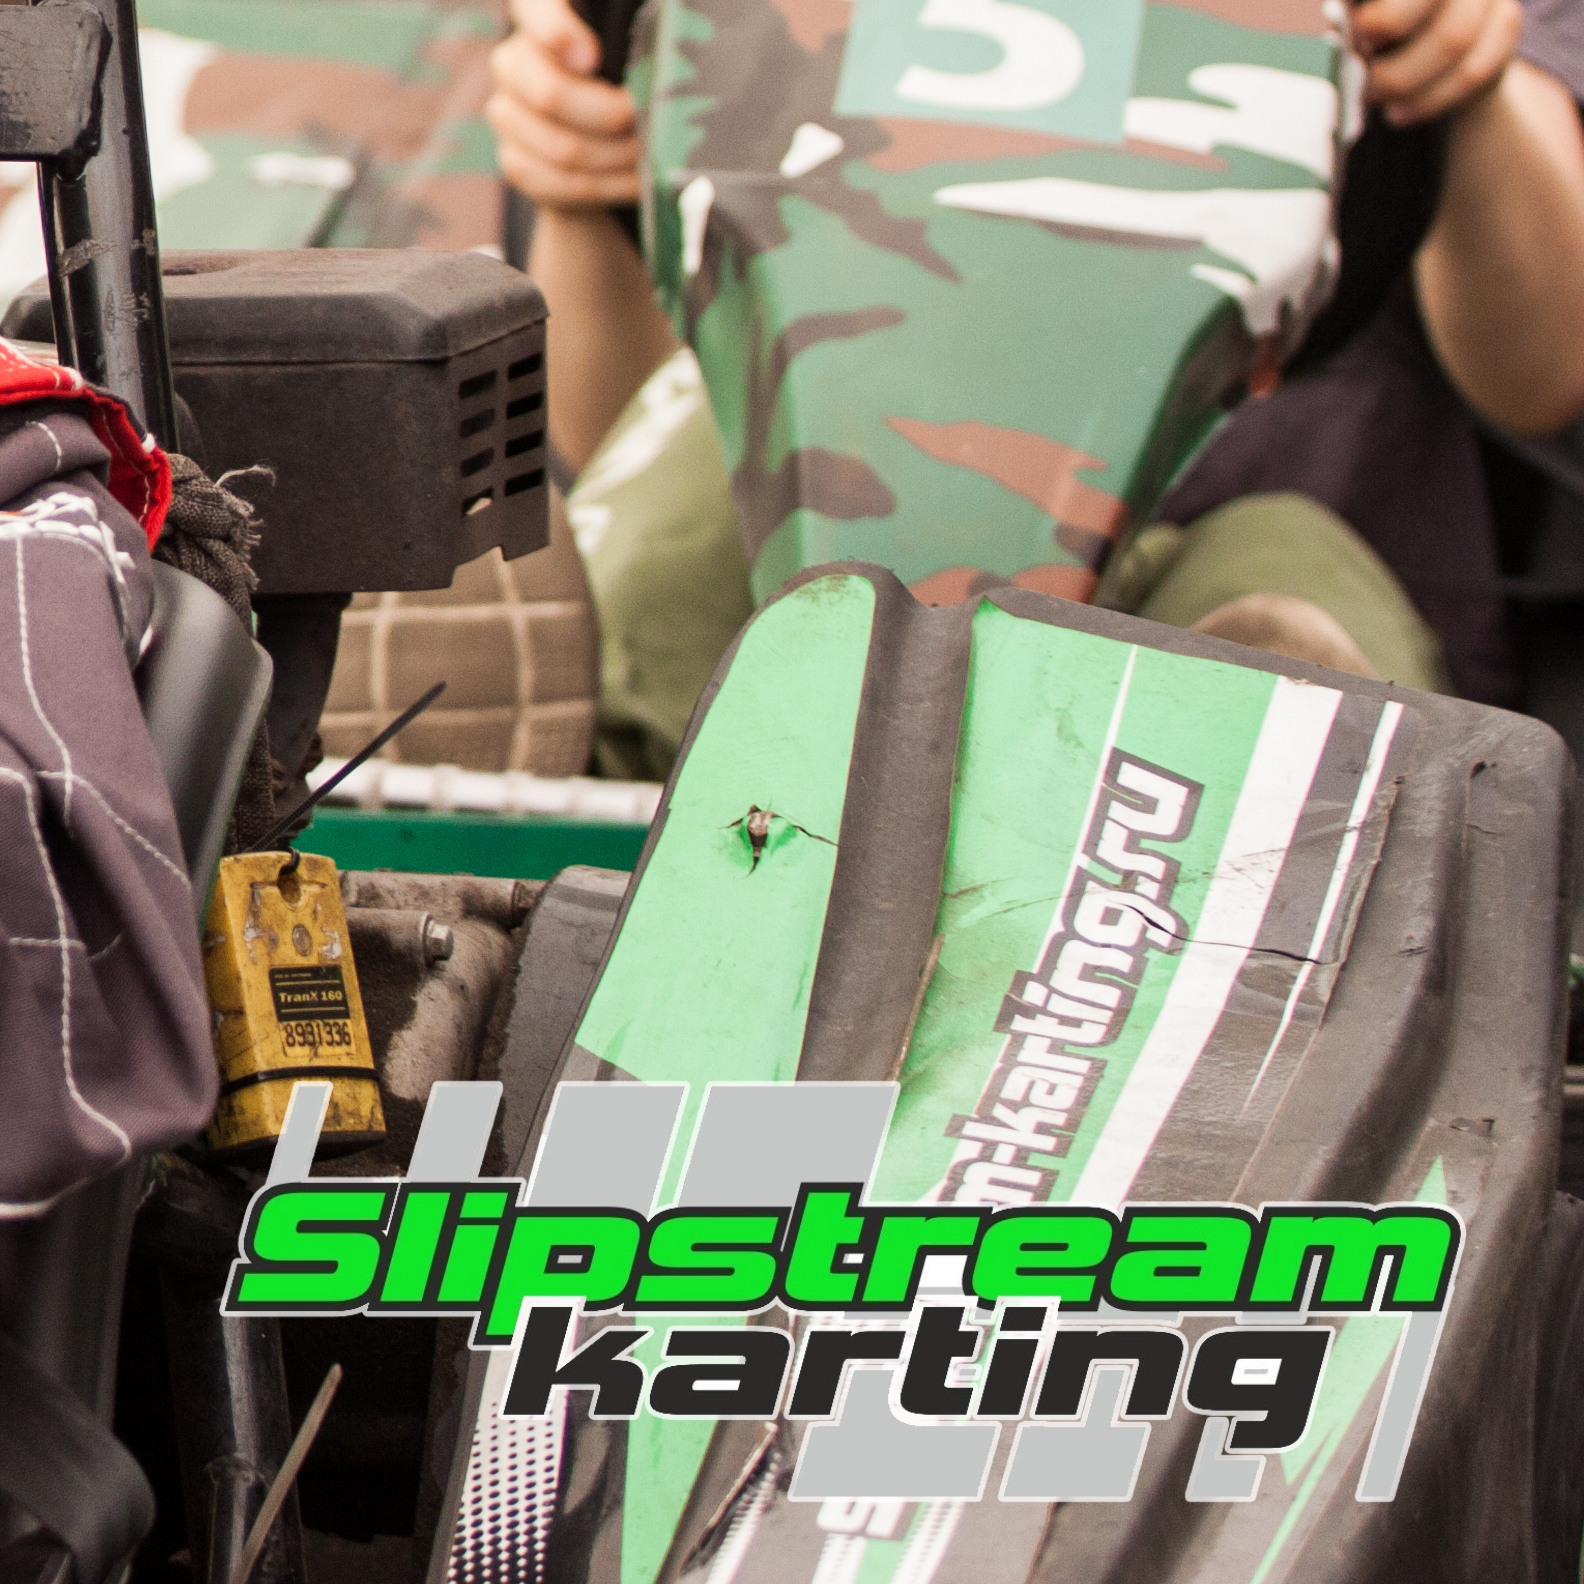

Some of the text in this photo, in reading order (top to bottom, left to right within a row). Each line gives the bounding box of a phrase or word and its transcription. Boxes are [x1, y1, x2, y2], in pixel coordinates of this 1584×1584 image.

[948, 754, 1196, 1206] m-karting.ru
[278, 989, 343, 1003] TranX 160
[284, 1020, 352, 1047] 8931336
